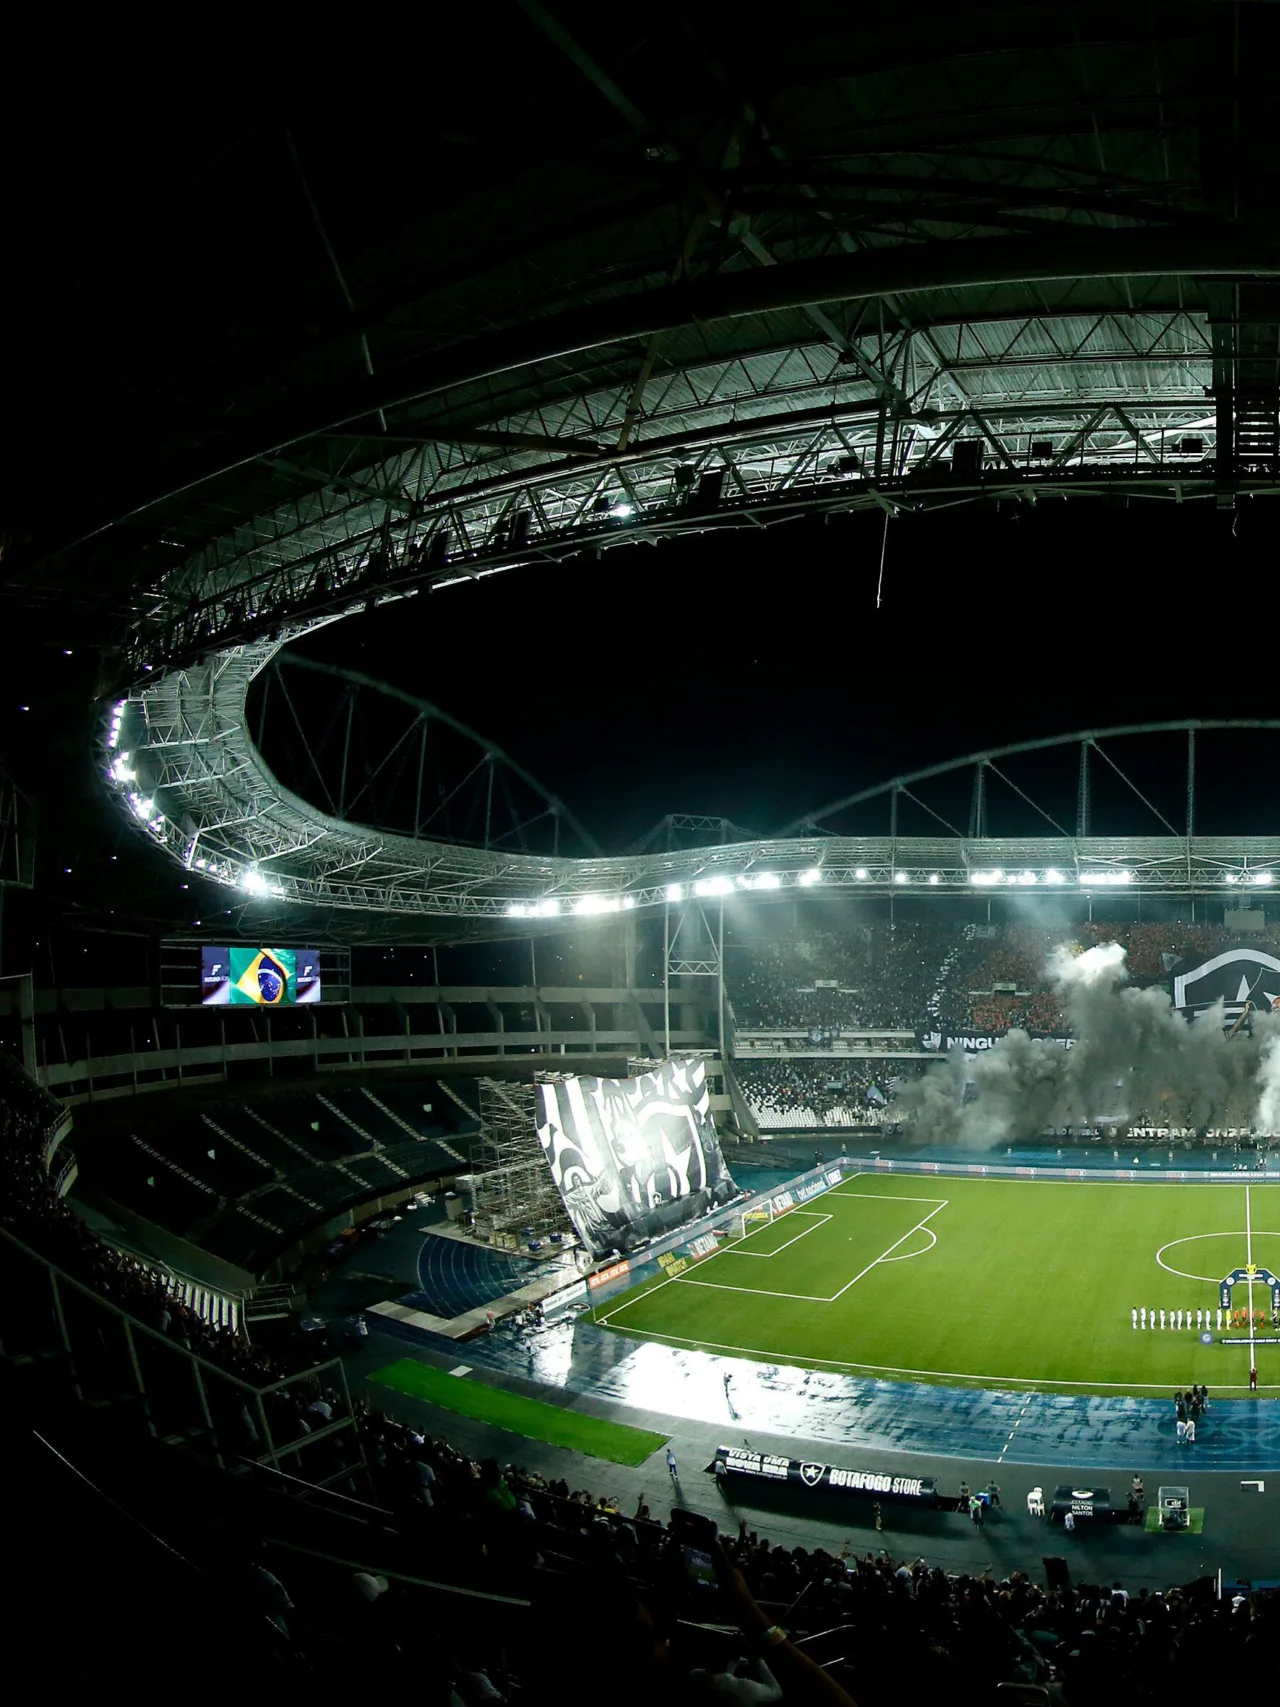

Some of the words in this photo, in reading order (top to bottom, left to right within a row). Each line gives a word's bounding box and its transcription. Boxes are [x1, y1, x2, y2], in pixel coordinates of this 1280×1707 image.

[728, 1449, 761, 1462] VISTA
[829, 1469, 892, 1492] BOTAFOGO
[892, 1477, 923, 1496] STORE
